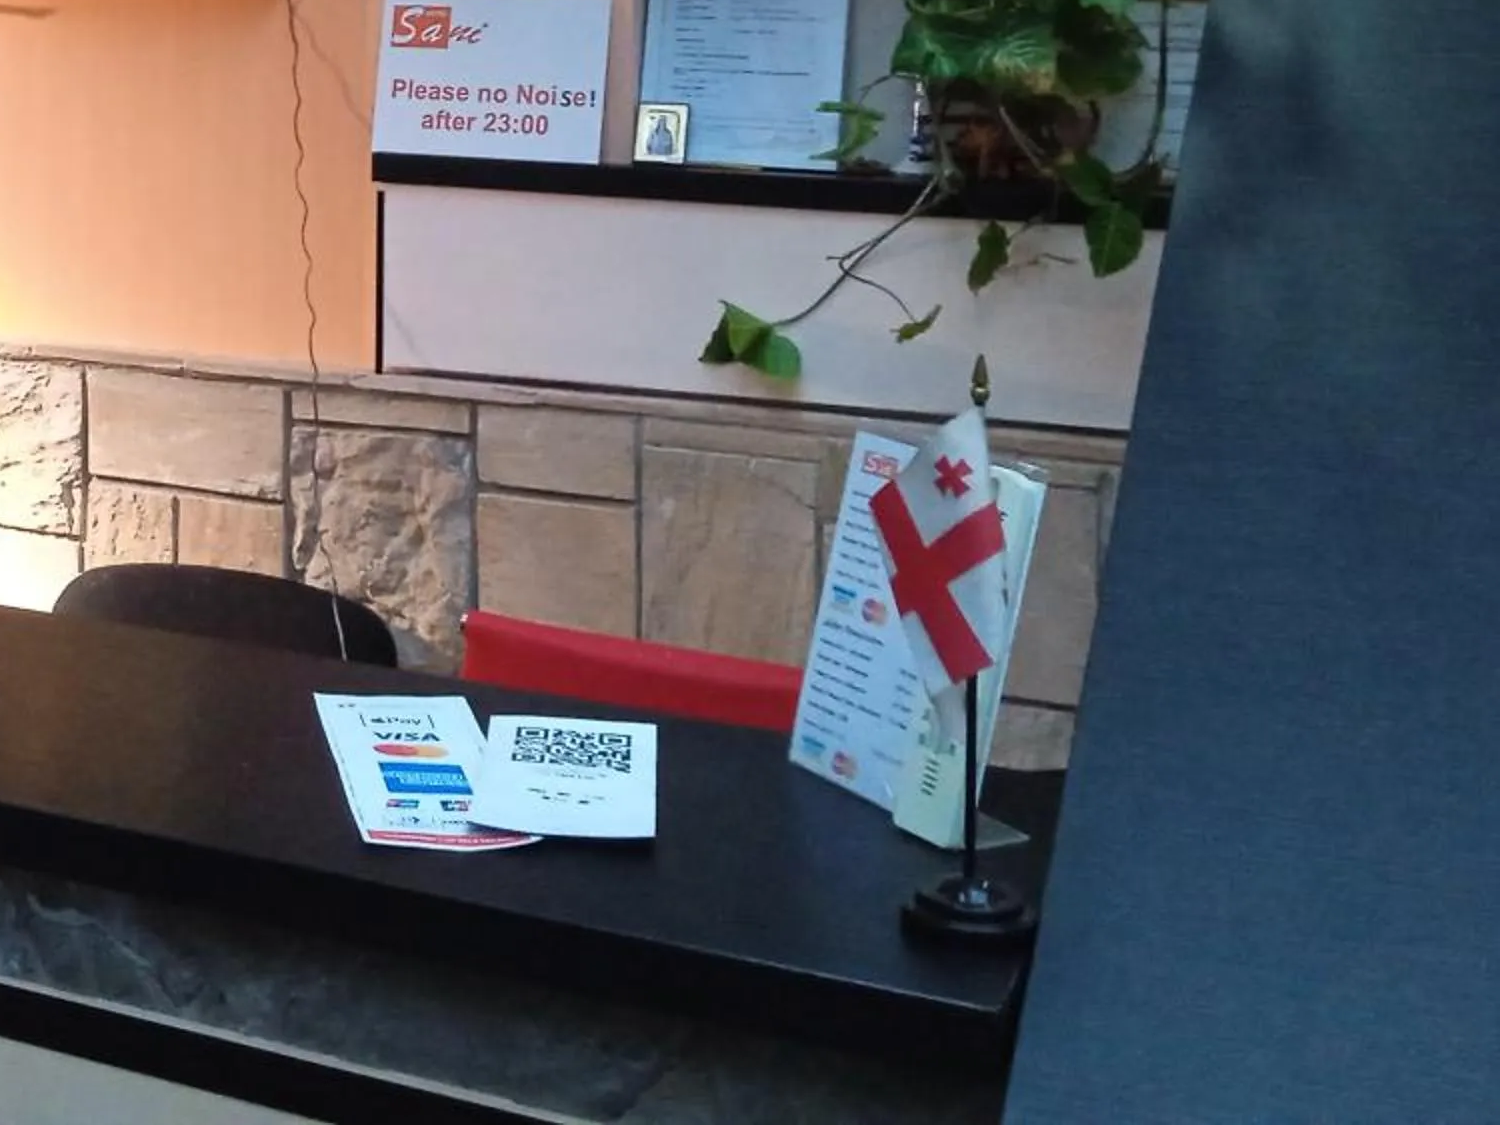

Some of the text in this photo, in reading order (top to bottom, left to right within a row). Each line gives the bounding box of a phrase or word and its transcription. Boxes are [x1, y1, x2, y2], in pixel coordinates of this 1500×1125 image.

[391, 79, 596, 108] Please no Noise!
[421, 110, 549, 136] after 23:00
[373, 731, 441, 742] VISA
